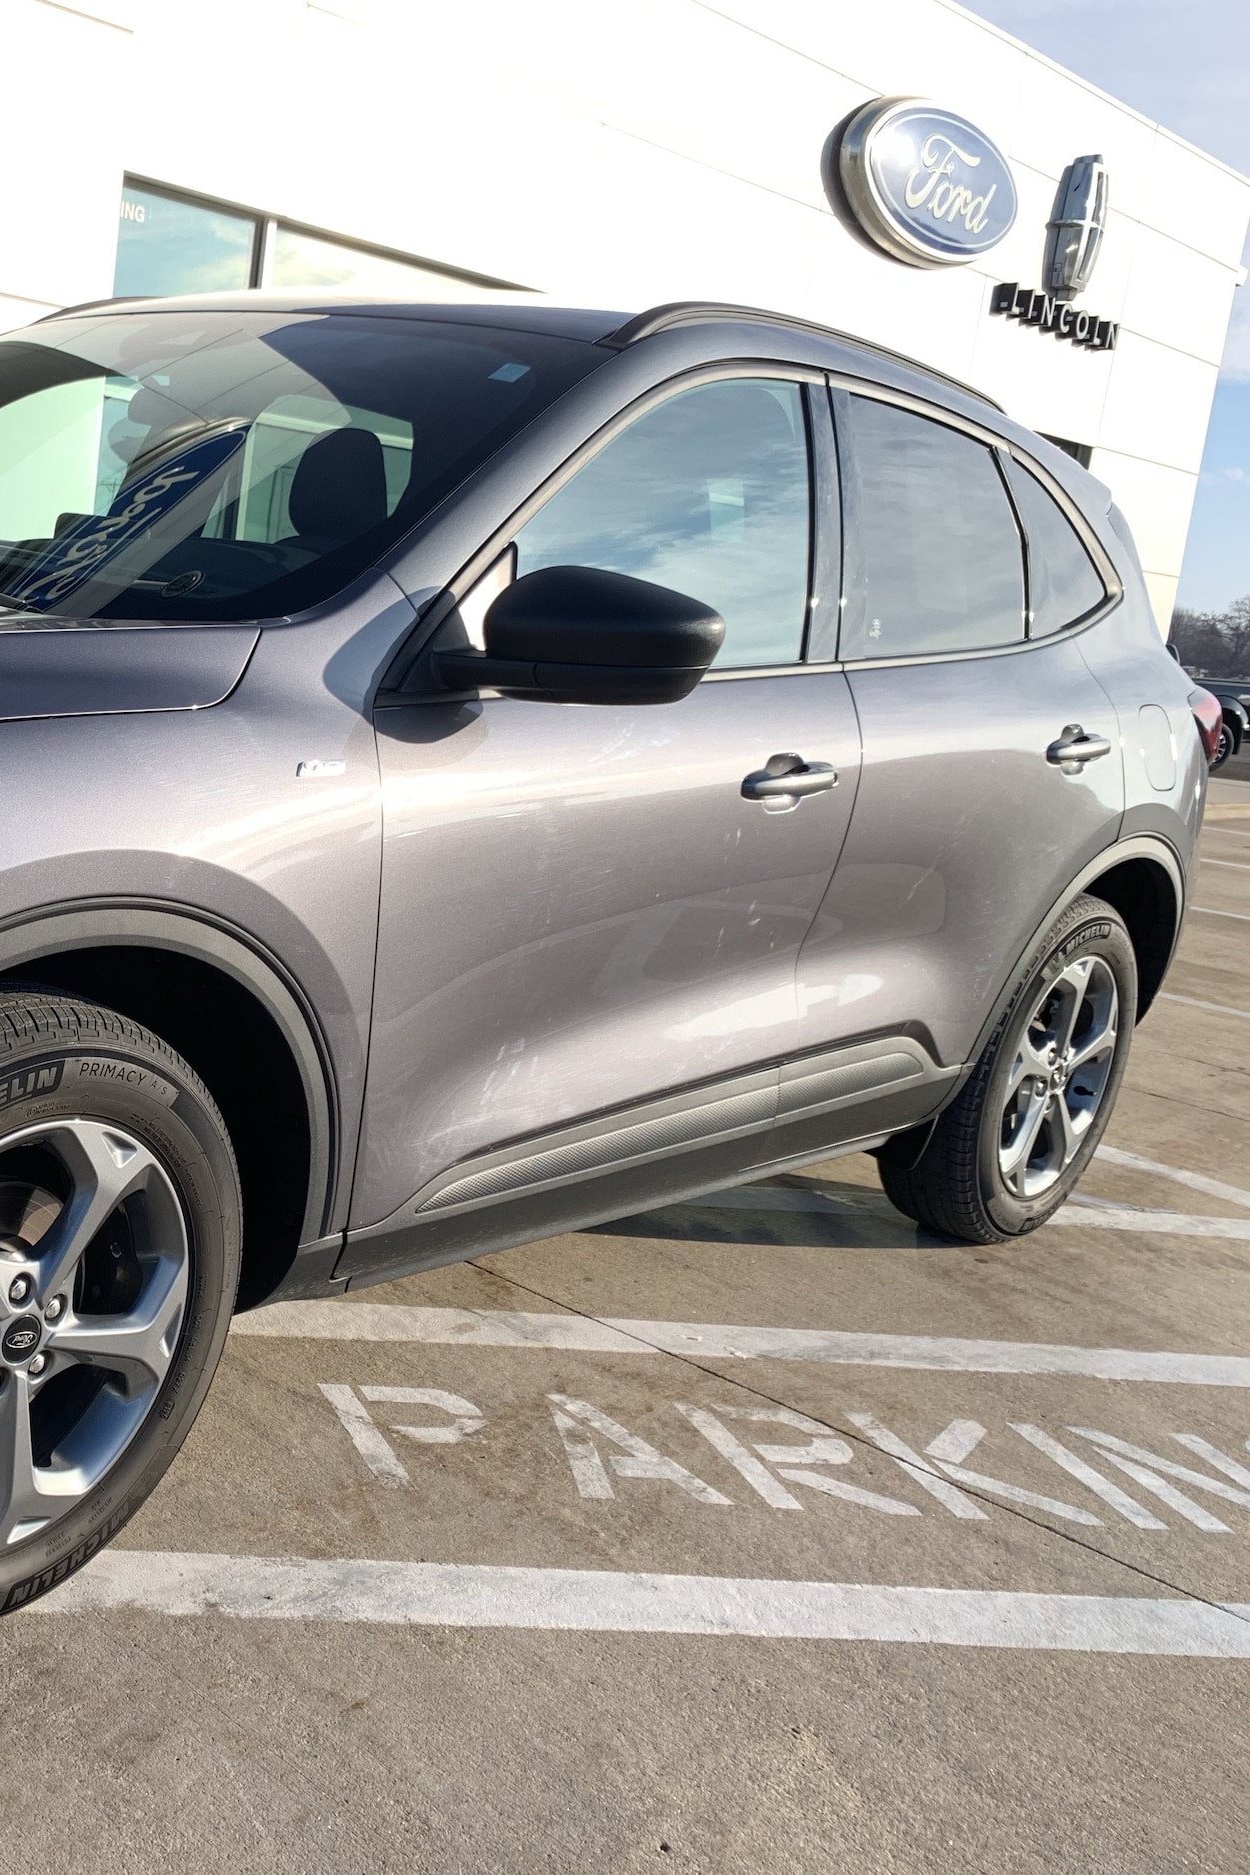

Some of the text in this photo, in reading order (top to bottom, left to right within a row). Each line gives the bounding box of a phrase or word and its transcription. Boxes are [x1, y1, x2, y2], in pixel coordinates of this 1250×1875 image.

[904, 132, 998, 234] Ford
[990, 282, 1120, 350] LINCOLN
[1066, 924, 1111, 954] MICHELIN
[78, 1062, 168, 1096] PRIMACY A/S
[316, 1383, 1250, 1535] PARKIN
[9, 1501, 129, 1606] MICHELIN
